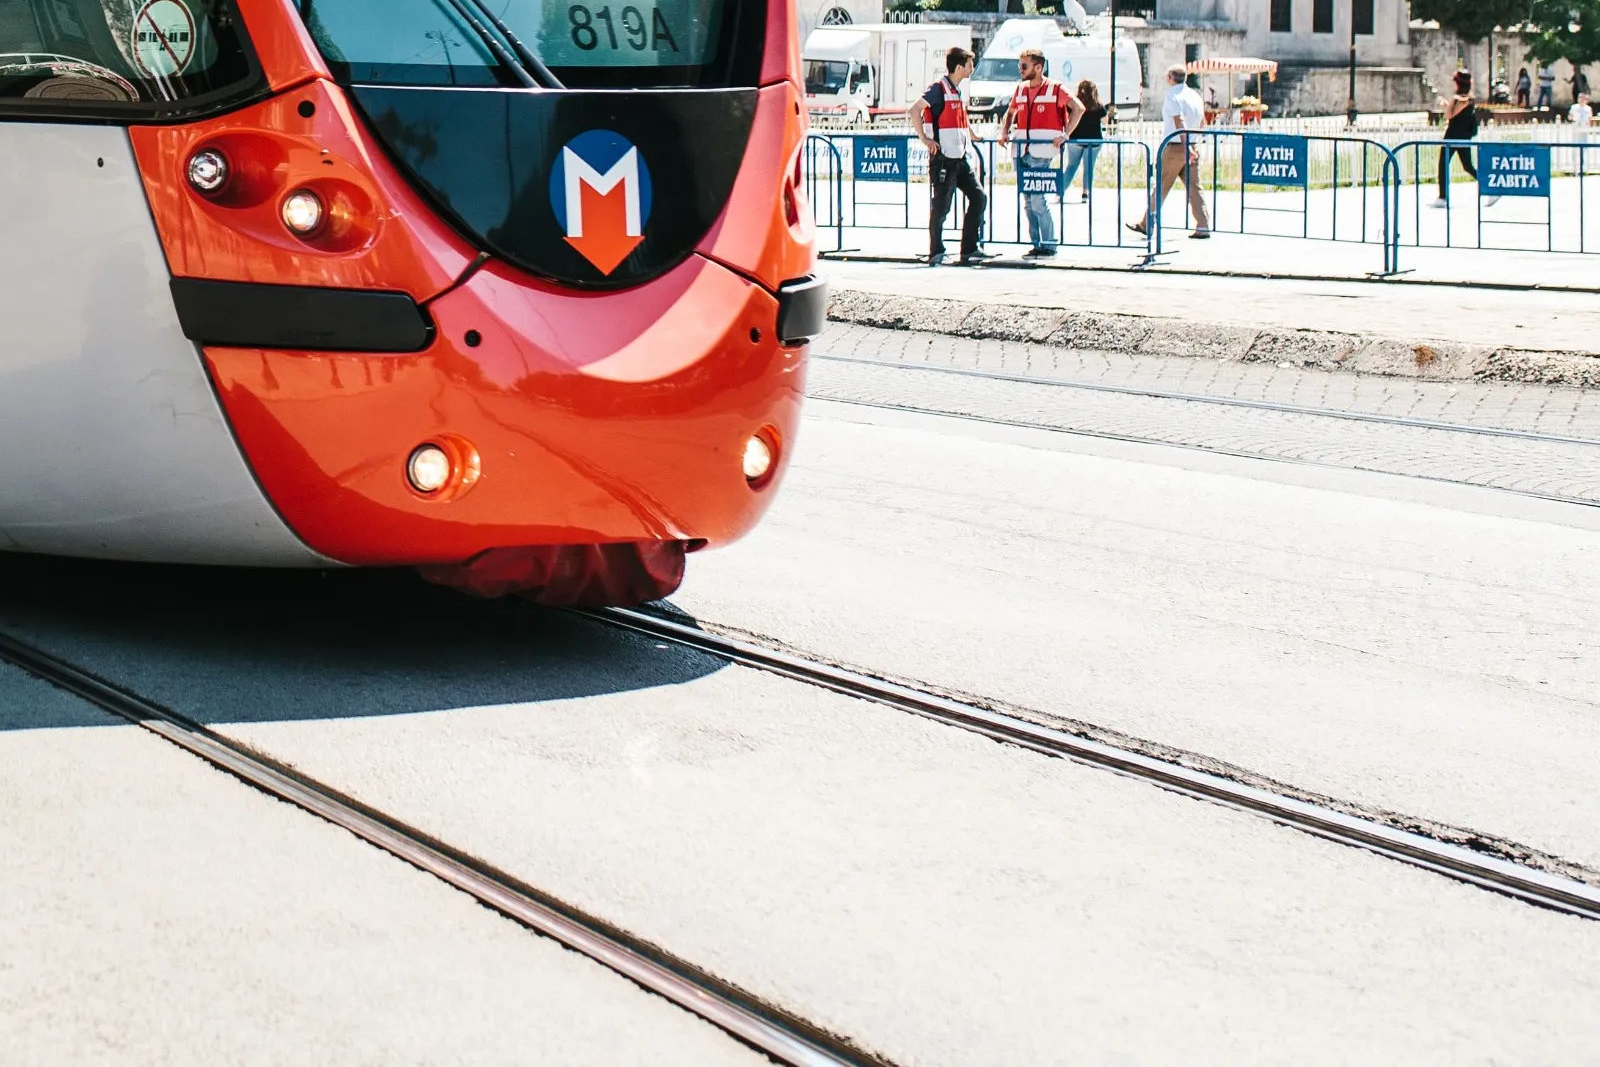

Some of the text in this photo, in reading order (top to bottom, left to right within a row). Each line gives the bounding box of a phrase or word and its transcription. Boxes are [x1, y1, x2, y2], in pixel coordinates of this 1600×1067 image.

[567, 2, 680, 52] 819A
[863, 145, 897, 159] FATİH
[1255, 145, 1294, 161] FATİH
[860, 162, 900, 174] ZABITA
[1491, 154, 1535, 170] FATİH
[1251, 163, 1298, 178] ZABITA
[1023, 179, 1057, 192] ZABITA
[1487, 174, 1539, 188] ZABITA
